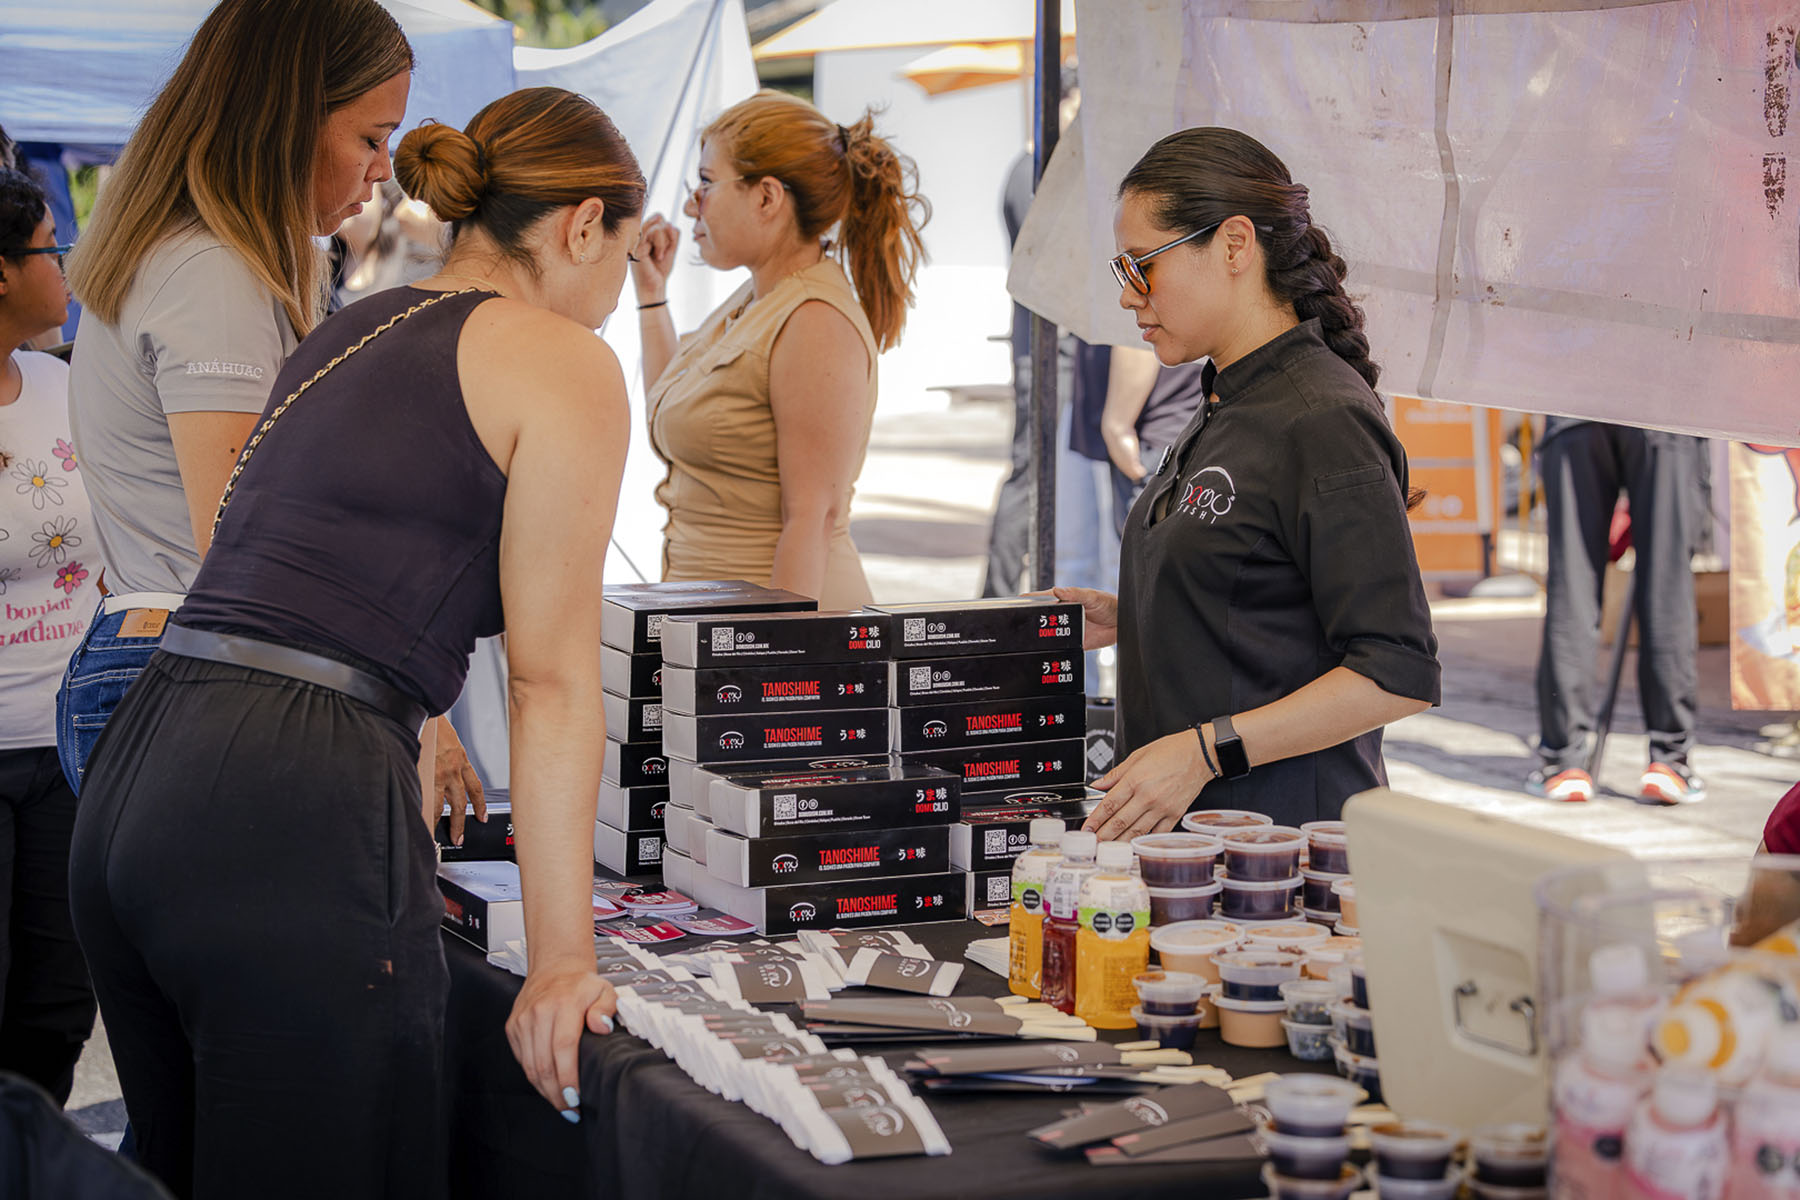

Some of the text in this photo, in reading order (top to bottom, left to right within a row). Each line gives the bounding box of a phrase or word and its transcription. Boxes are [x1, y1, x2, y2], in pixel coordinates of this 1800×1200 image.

[186, 358, 263, 378] ANÁHUAC
[761, 681, 821, 697] TANOSHIME
[965, 713, 1022, 731] TANOSHIME
[763, 726, 823, 743] TANOSHIME
[963, 760, 1020, 777] TANOSHIME
[819, 846, 880, 865] TANOSHIME
[836, 894, 898, 913] TANOSHIME
